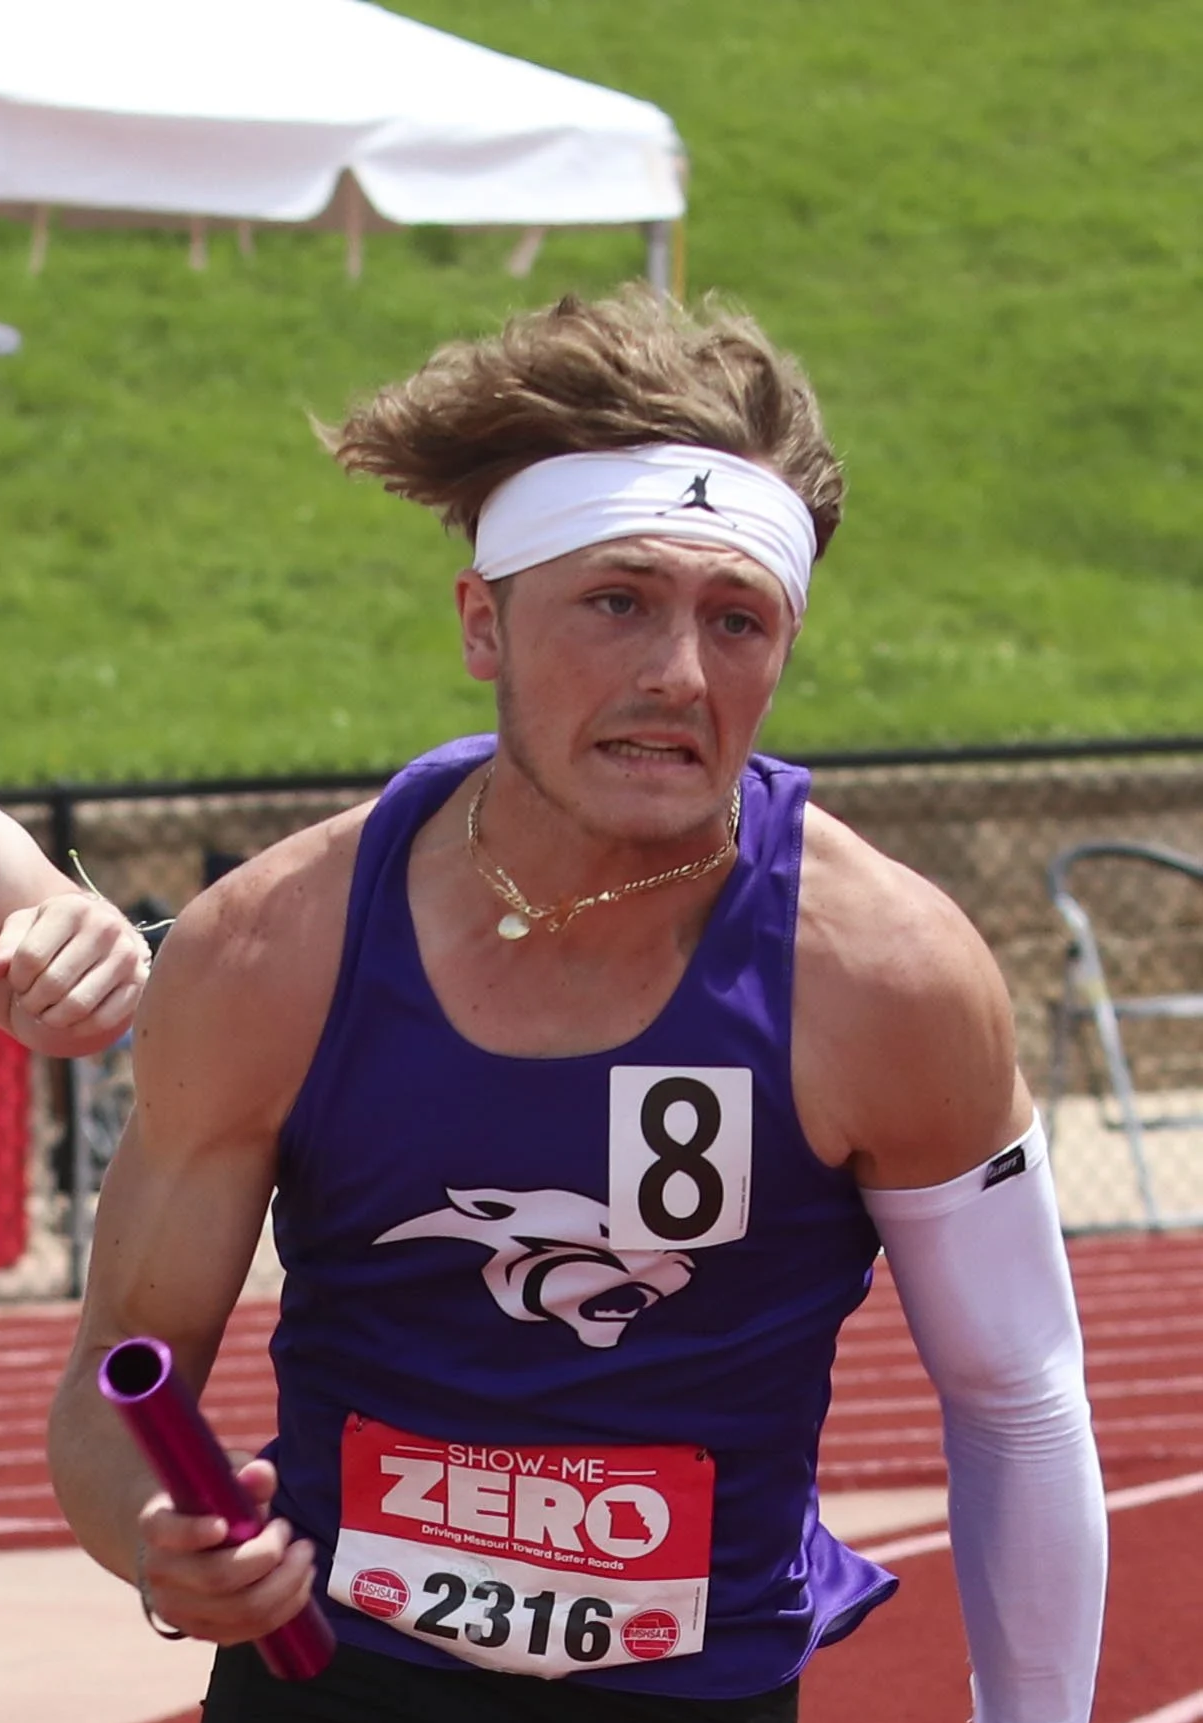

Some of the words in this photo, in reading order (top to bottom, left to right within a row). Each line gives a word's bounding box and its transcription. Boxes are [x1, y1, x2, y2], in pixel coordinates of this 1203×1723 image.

[638, 1076, 724, 1241] 8
[380, 1454, 670, 1559] ZERO
[448, 1444, 605, 1483] SHOW-ME
[421, 1524, 462, 1543] Driving
[463, 1533, 510, 1550] Missouri
[511, 1541, 553, 1559] Toward
[554, 1551, 586, 1565] Safer
[587, 1558, 625, 1571] Roads
[414, 1571, 614, 1663] 2316
